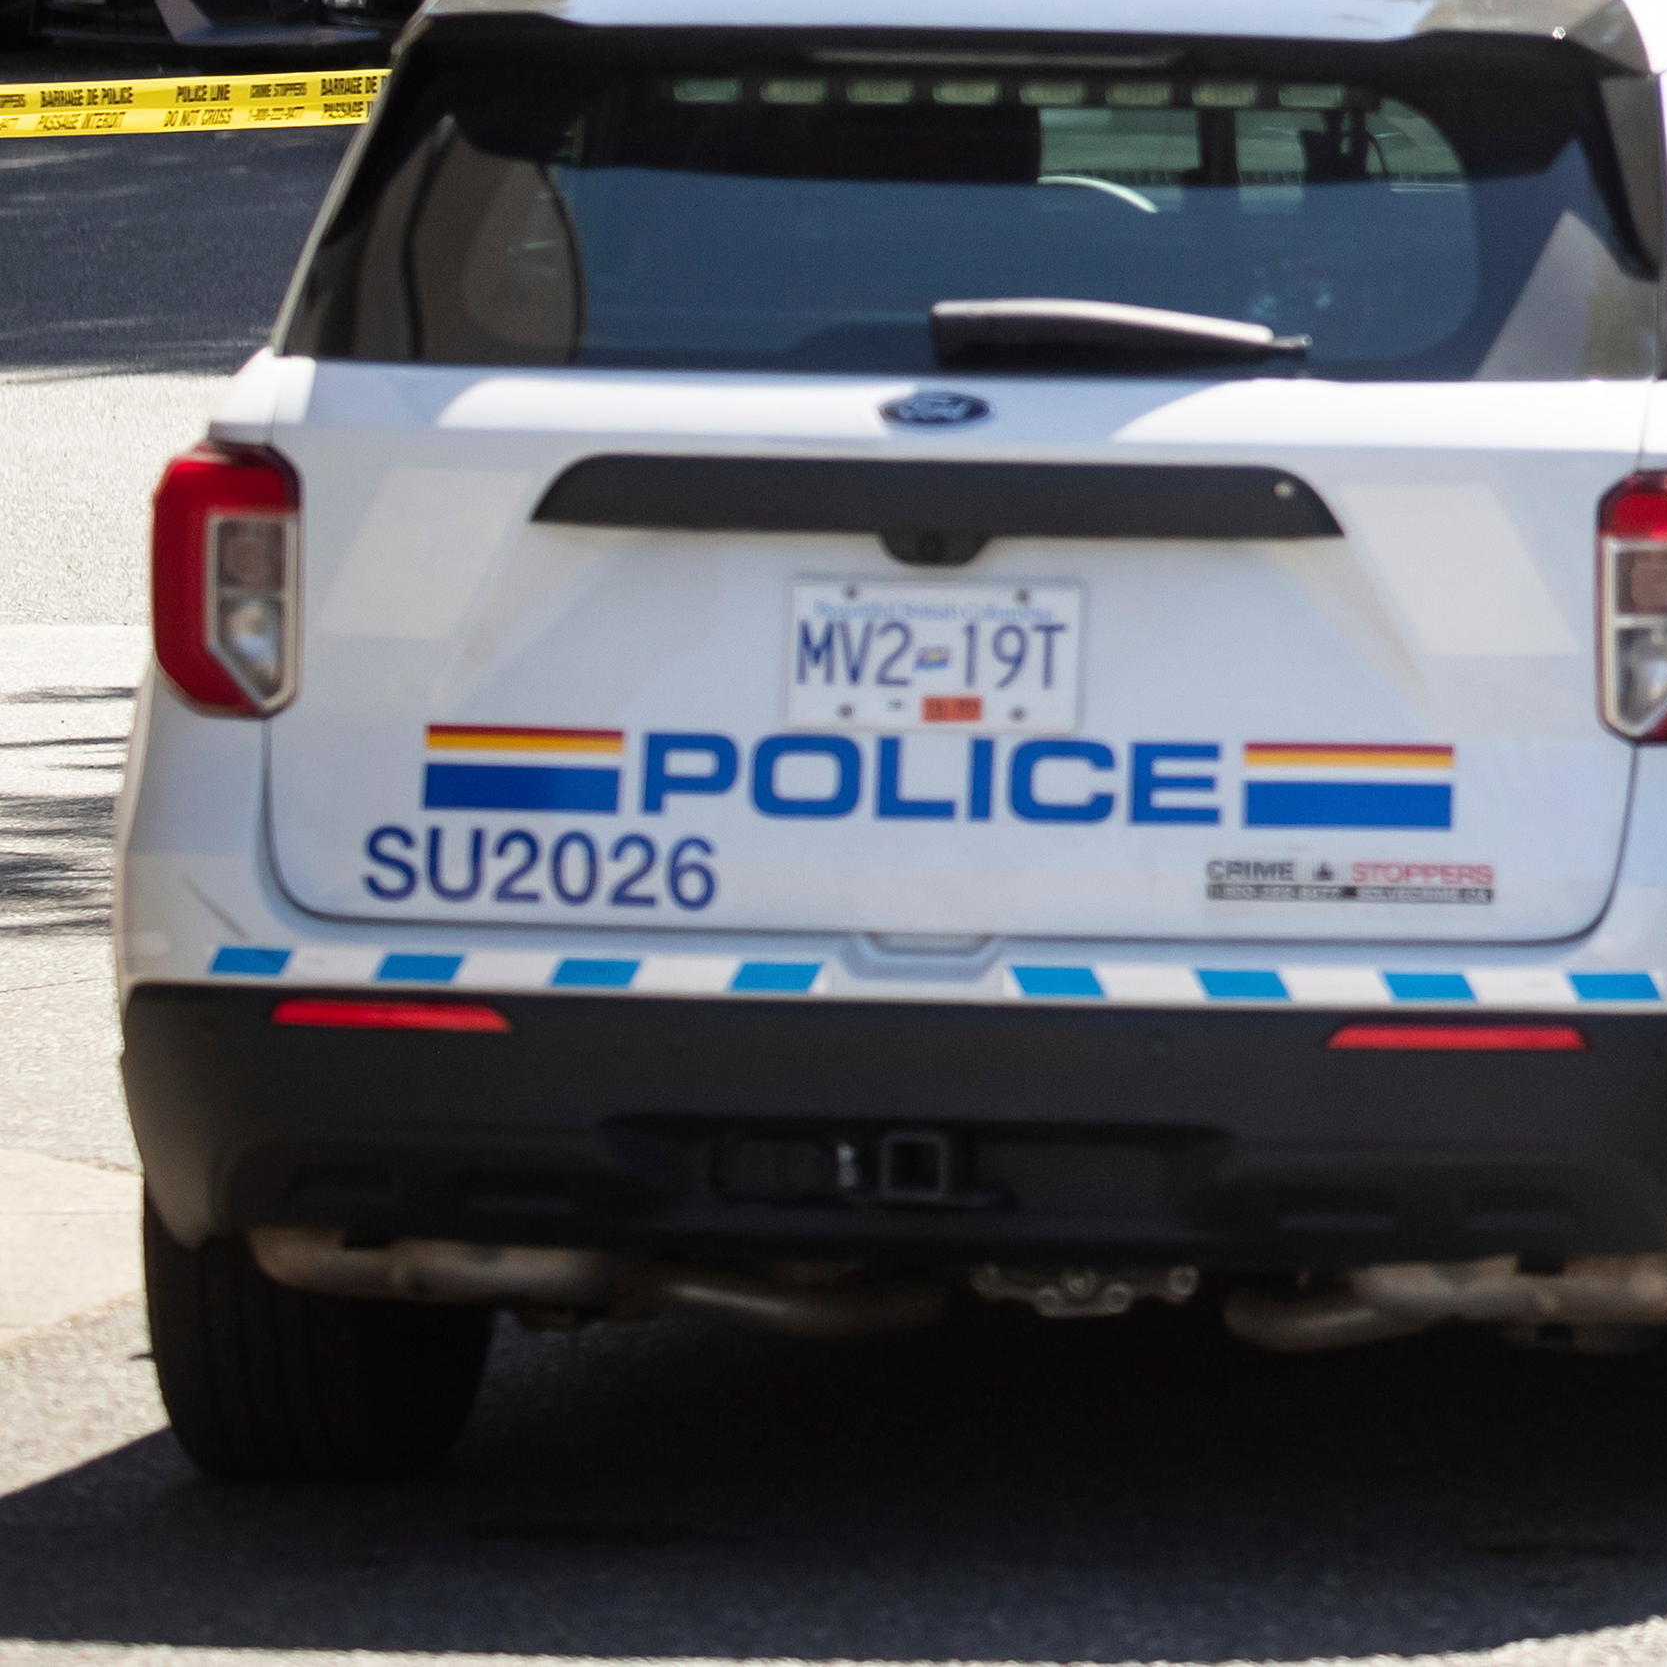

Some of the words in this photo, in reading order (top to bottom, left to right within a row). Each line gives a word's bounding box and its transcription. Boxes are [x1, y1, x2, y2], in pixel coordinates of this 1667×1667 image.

[101, 86, 133, 105] POLICE
[176, 84, 208, 103] POLICE
[210, 84, 231, 102] LINE
[641, 731, 1222, 827] POLICE
[362, 824, 719, 913] SU2026
[1206, 860, 1295, 881] CRIME
[1352, 862, 1494, 885] STOPPERS
